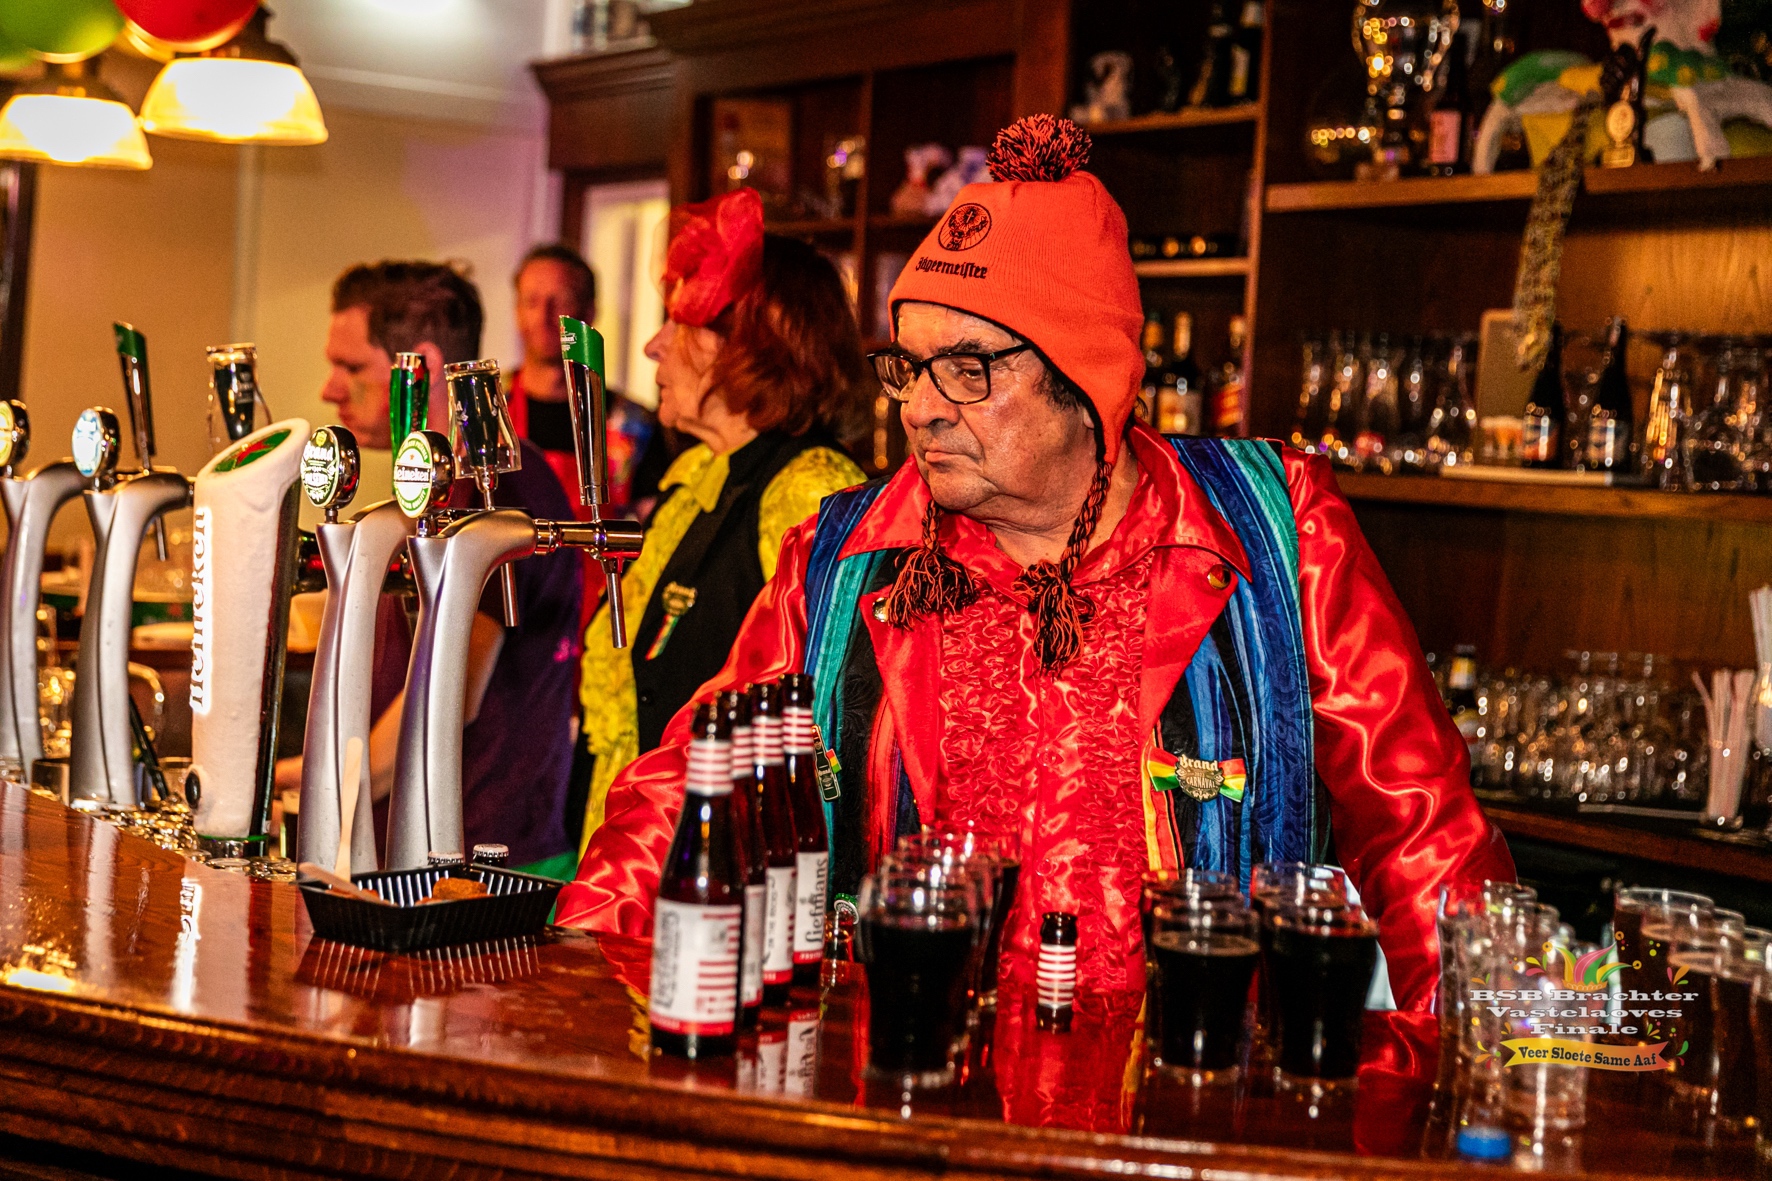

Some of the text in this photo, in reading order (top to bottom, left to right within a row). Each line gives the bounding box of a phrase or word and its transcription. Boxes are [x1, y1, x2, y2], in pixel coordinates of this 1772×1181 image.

[189, 508, 210, 713] Heineken
[1179, 754, 1219, 771] Brand
[1186, 776, 1216, 788] CARNAVAL
